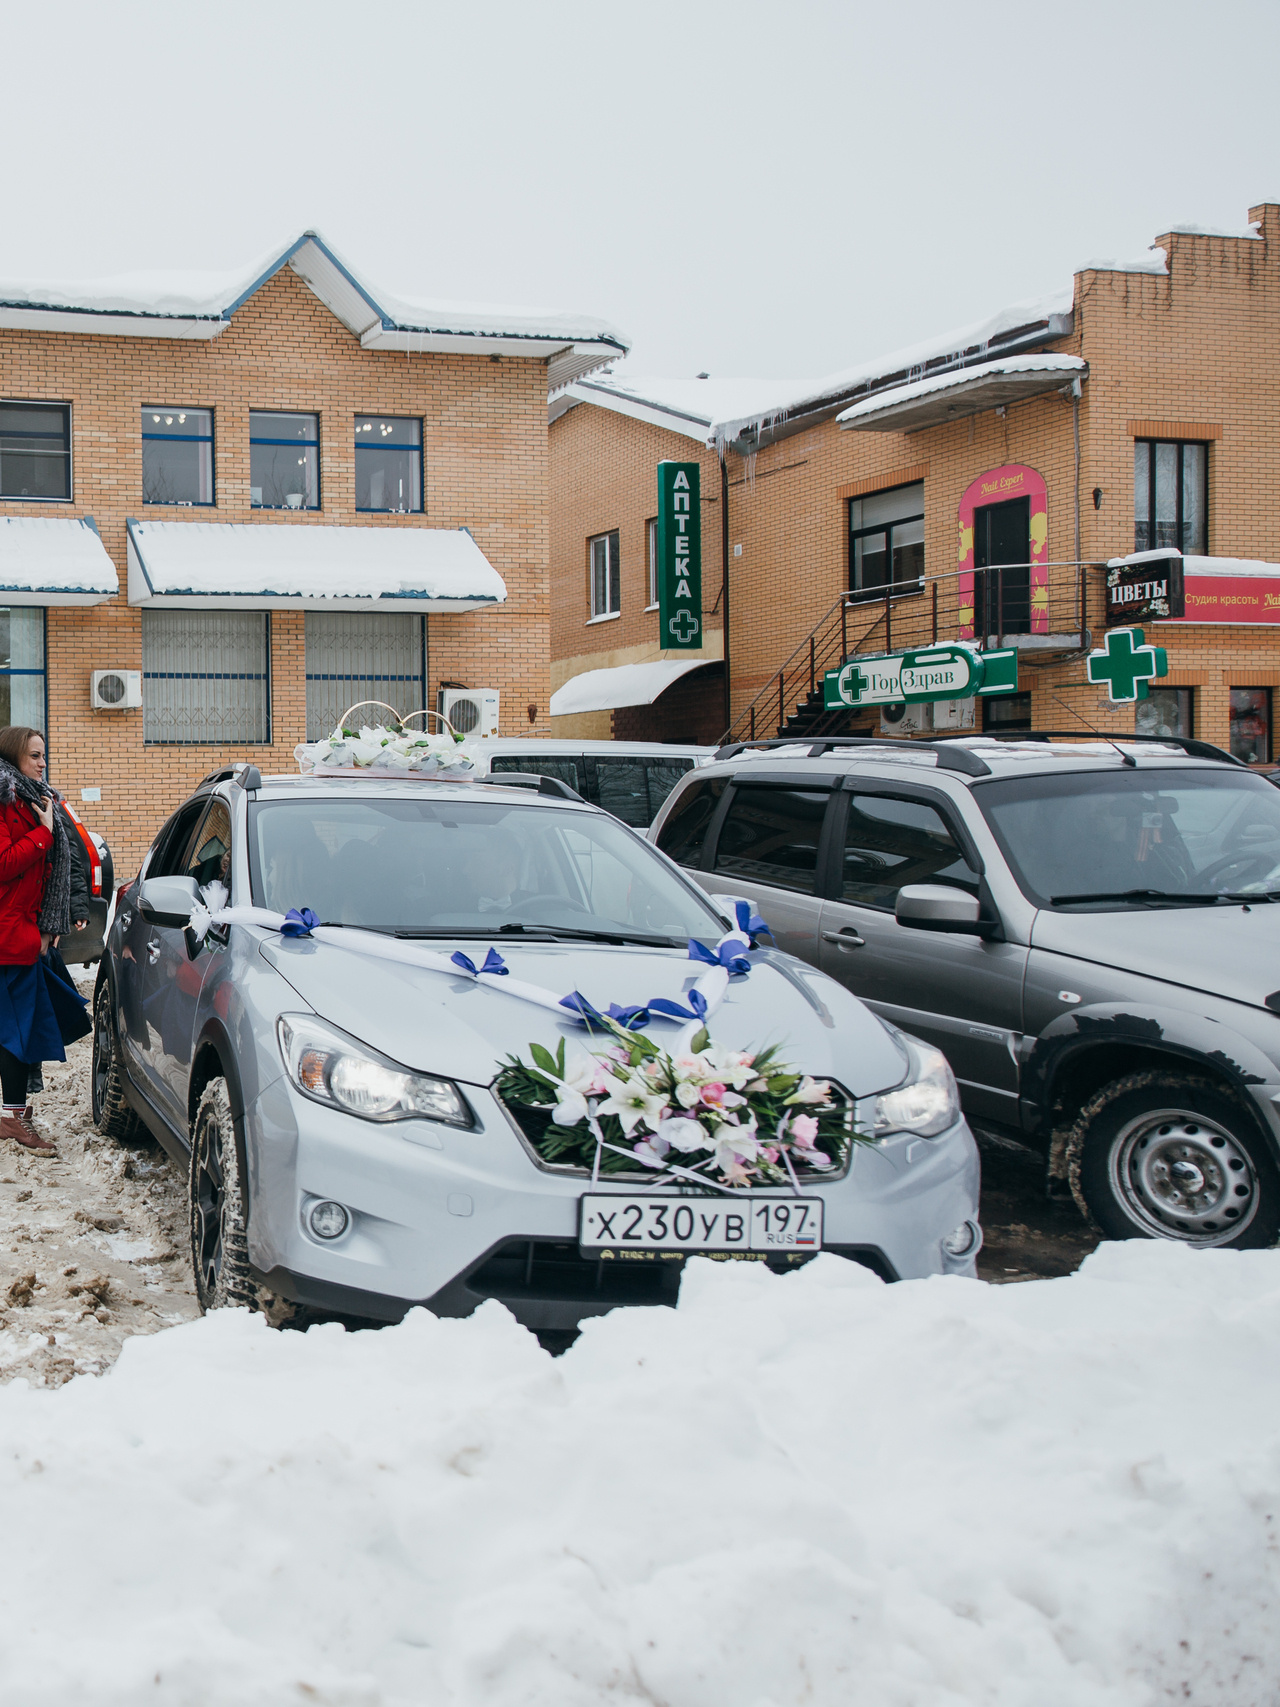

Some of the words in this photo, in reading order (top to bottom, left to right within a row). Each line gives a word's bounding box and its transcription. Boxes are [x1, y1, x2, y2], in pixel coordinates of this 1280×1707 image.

[980, 480, 998, 494] Nail
[1000, 472, 1024, 489] Expert
[673, 470, 692, 598] АПТЕКА
[1111, 579, 1167, 606] ЦВЕТЫ
[1184, 593, 1218, 606] Студия
[1220, 596, 1259, 606] красоты
[756, 1205, 810, 1232] 197
[766, 1233, 794, 1244] RUS
